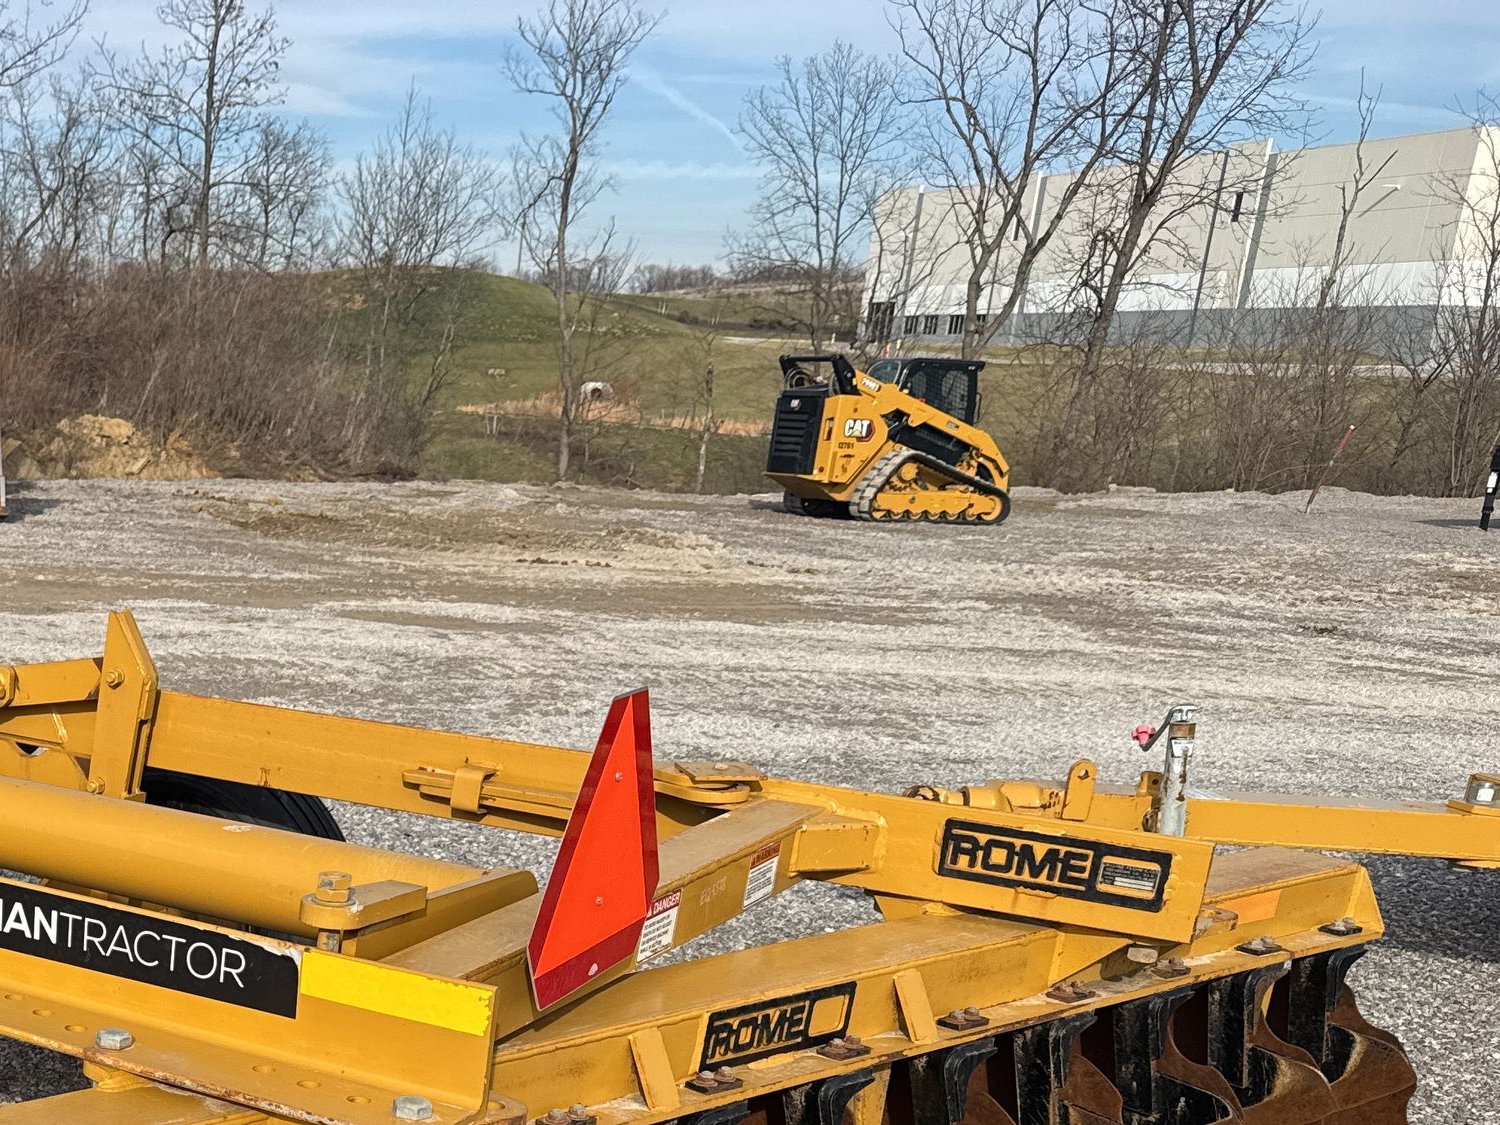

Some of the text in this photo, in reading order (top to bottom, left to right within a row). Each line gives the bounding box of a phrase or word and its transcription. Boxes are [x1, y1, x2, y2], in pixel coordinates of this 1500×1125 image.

[844, 419, 870, 437] CAT
[949, 834, 1089, 885] ROME
[652, 891, 680, 915] DANGER
[708, 1004, 805, 1059] ROME
